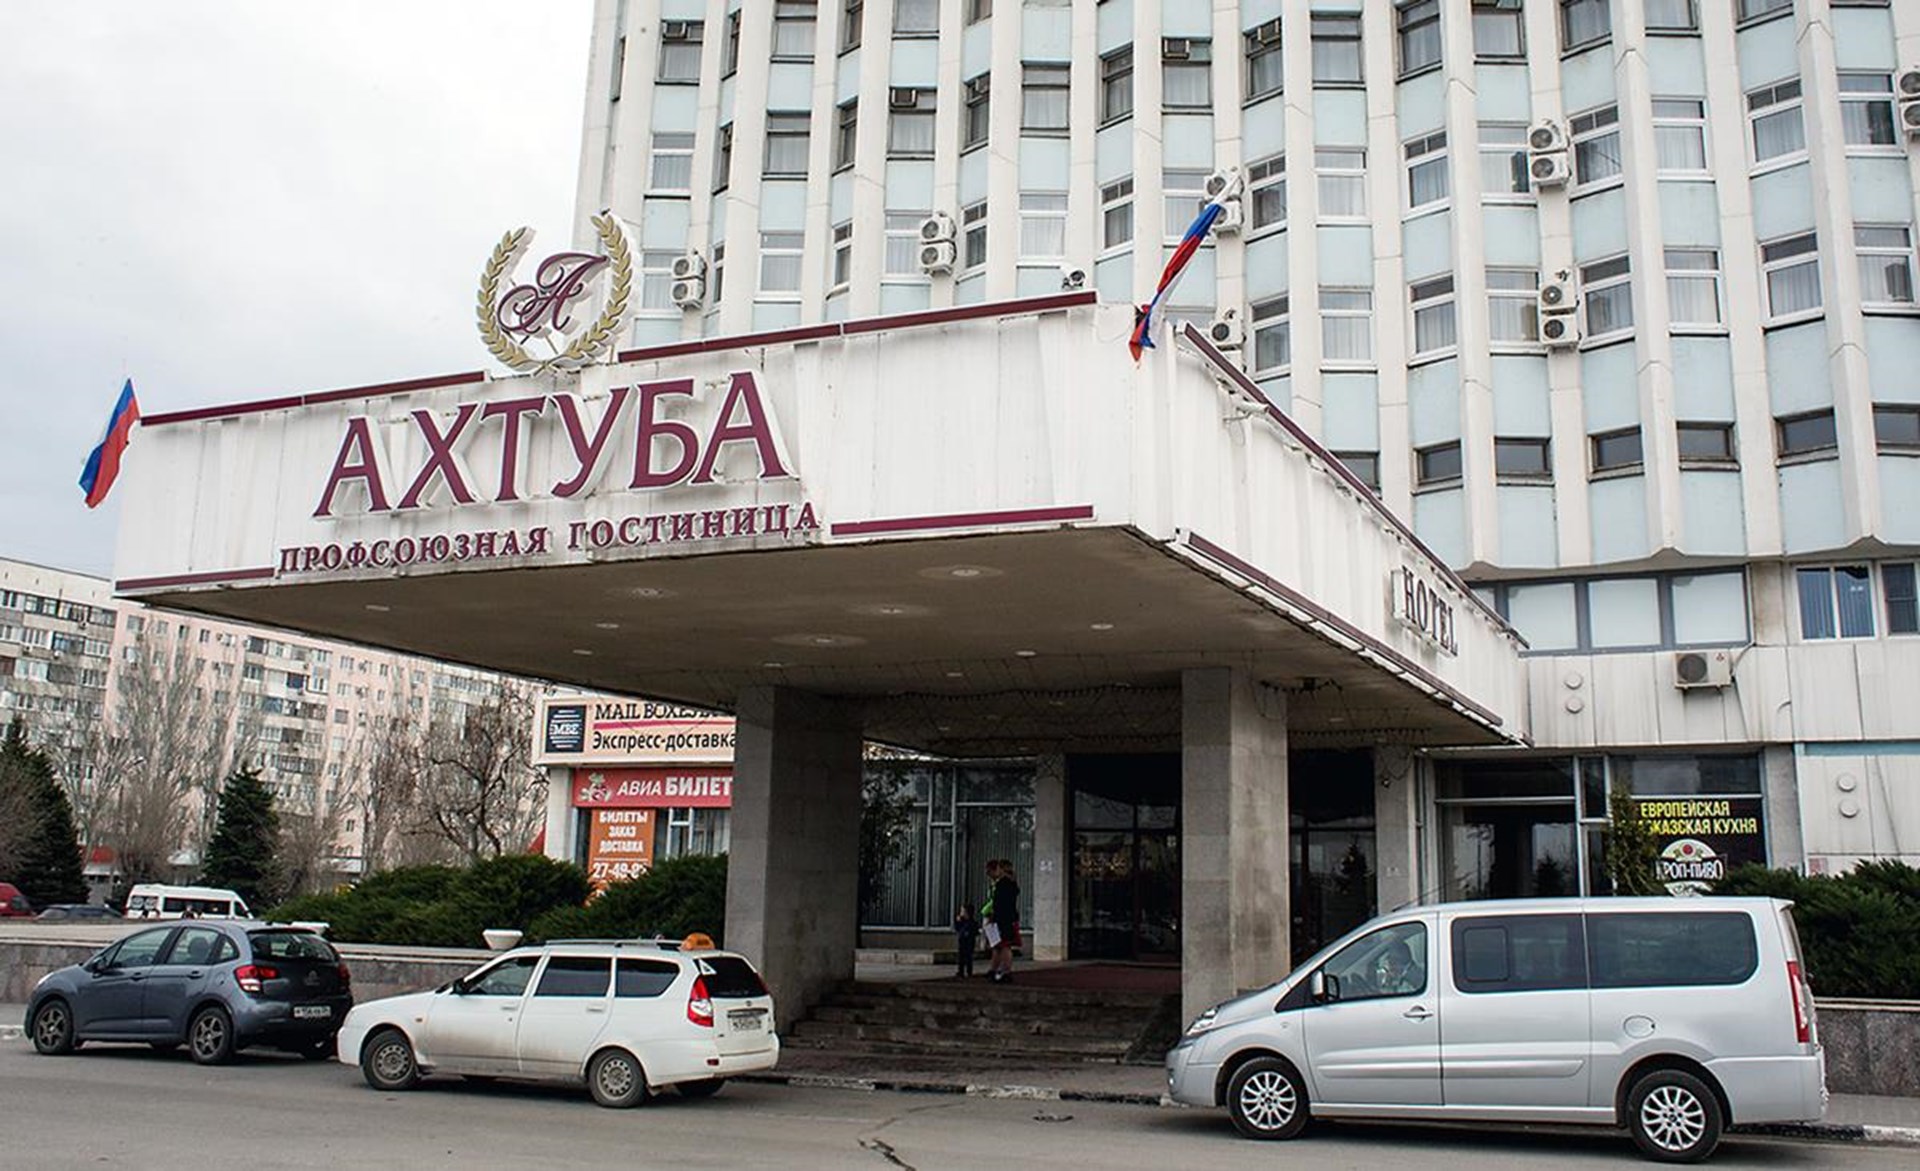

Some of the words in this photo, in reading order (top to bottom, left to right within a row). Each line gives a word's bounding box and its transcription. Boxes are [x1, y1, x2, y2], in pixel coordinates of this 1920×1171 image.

[312, 371, 791, 518] АХТУБА
[279, 526, 549, 574] ПРОФСОЮЗНАЯ
[568, 502, 821, 551] ГОСТИНИЦА
[1402, 565, 1458, 656] HOTEL
[594, 702, 640, 720] MAIL
[592, 731, 736, 753] Экспресс-доставка
[617, 780, 662, 797] АВИА
[599, 811, 648, 823] БИЛЕТЫ
[1640, 801, 1730, 817] ЕВРОПЕЙСКАЯ
[608, 826, 637, 838] ЗАКАЗ
[1713, 818, 1757, 834] КУХНЯ
[600, 840, 644, 853] ДОСТАВКА
